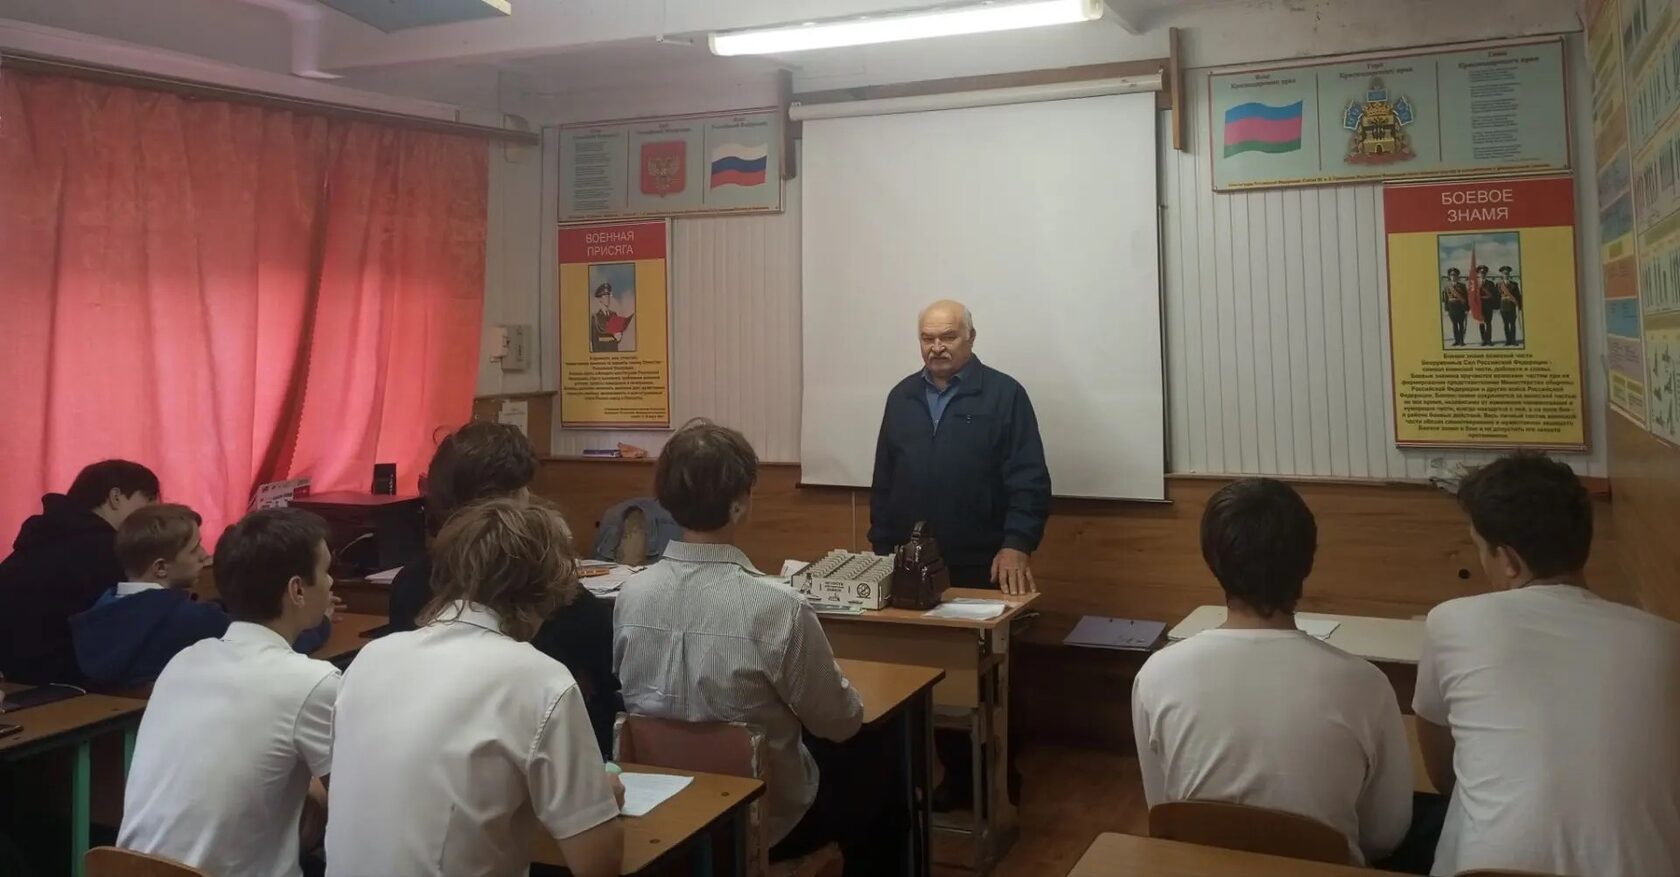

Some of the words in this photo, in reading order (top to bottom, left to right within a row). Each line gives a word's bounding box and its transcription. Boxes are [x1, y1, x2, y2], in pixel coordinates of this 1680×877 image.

[1441, 189, 1513, 205] БОЕВОЕ
[1447, 207, 1509, 223] ЗНАМЯ
[586, 231, 635, 243] ВОЕННАЯ
[587, 246, 634, 257] ПРИСЯГА
